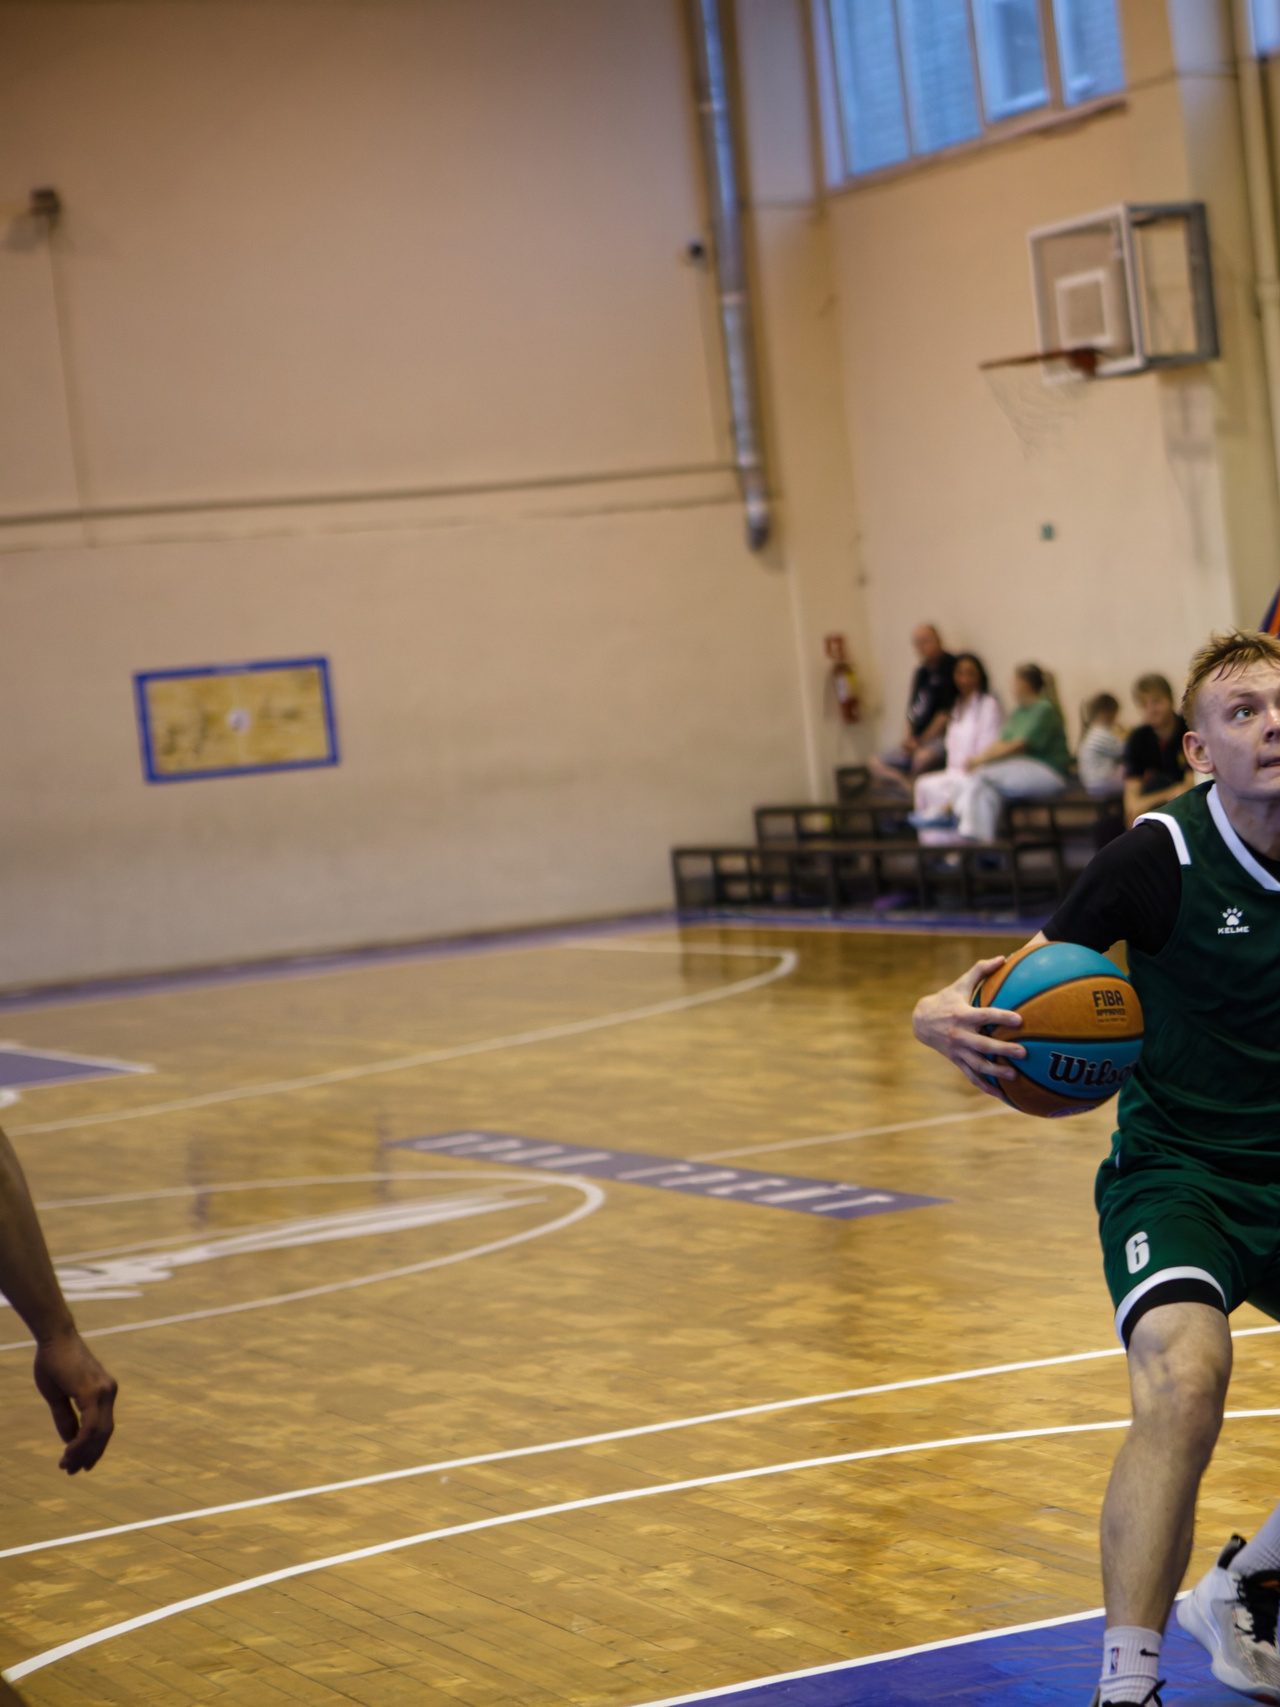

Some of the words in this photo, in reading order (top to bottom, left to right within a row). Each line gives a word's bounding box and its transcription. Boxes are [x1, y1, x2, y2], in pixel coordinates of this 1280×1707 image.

[1217, 926, 1250, 934] KELME
[1092, 989, 1124, 1007] FIBA
[1125, 1231, 1150, 1274] 6
